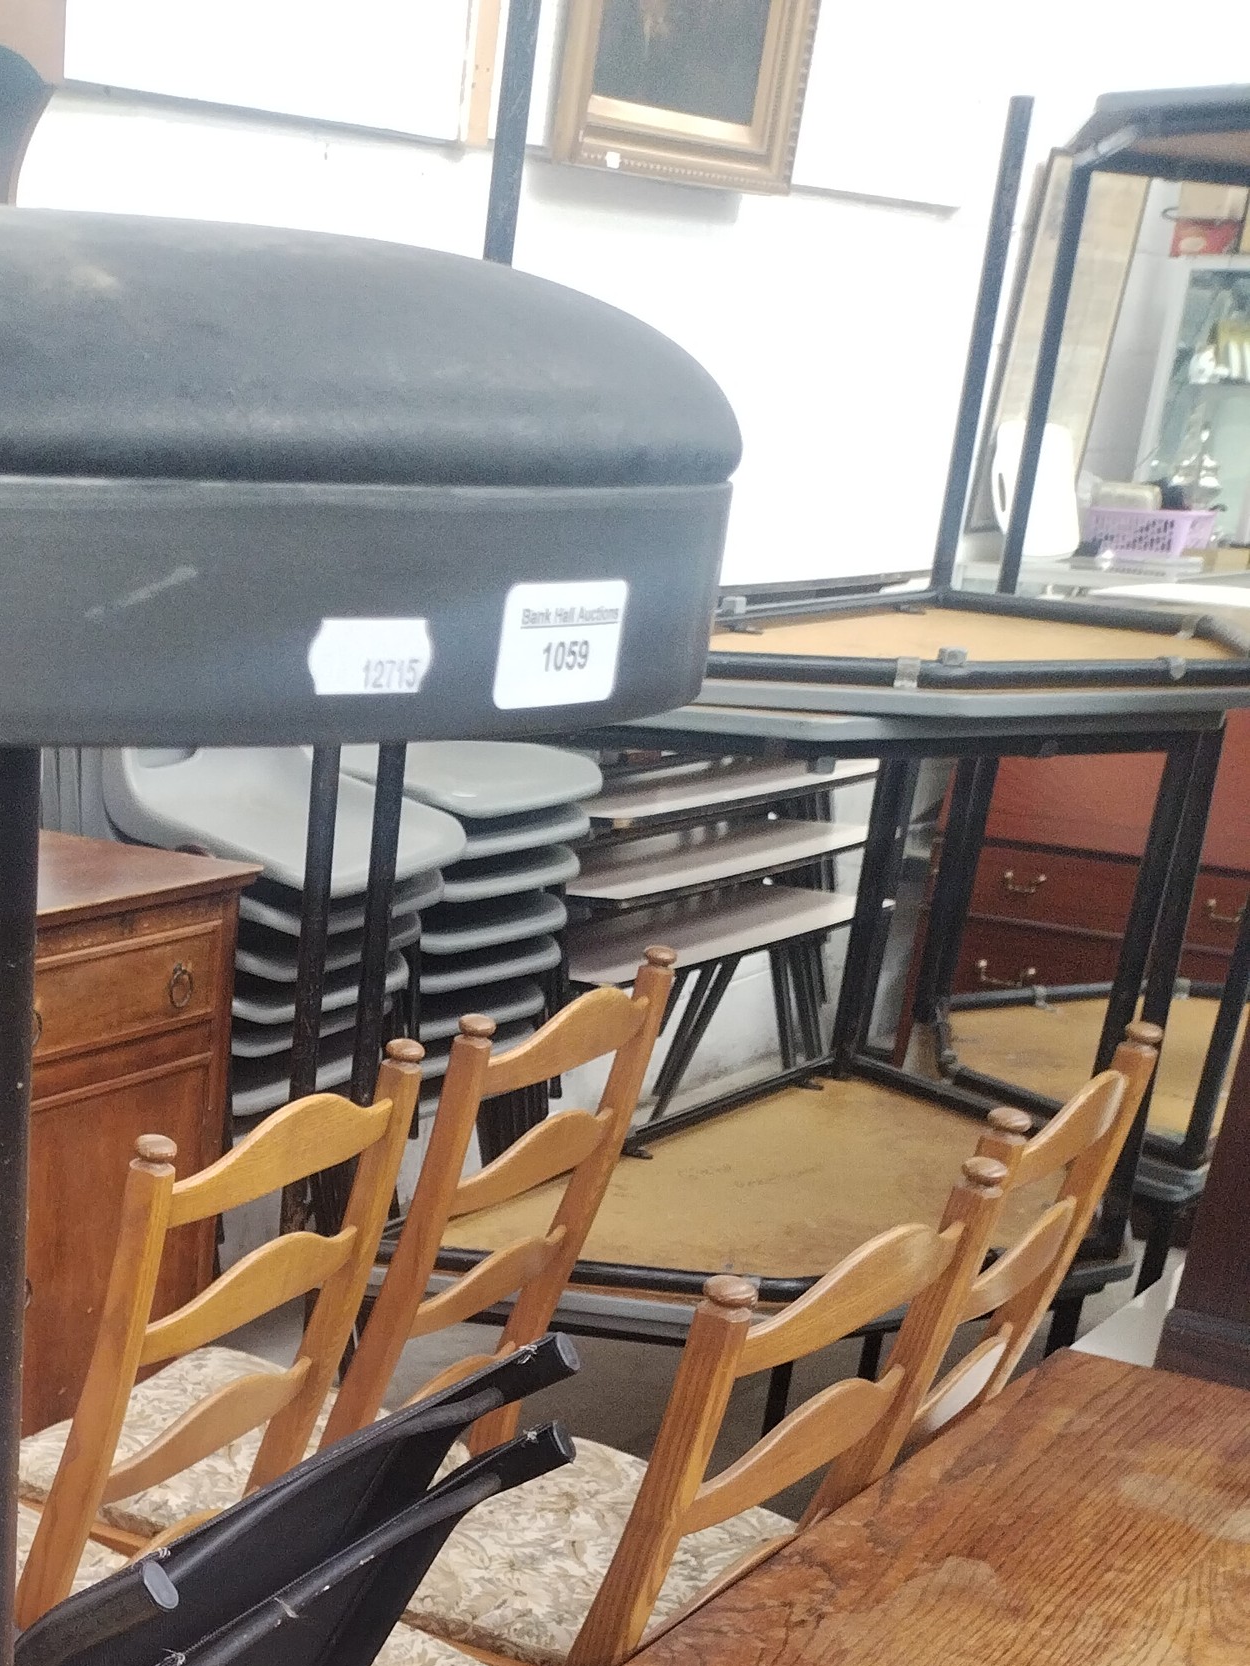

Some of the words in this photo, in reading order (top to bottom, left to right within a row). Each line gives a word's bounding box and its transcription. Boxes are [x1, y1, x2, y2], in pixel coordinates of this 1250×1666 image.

[520, 608, 551, 626] Bank
[554, 607, 576, 624] Hall
[577, 605, 619, 622] Auctions
[543, 640, 589, 672] 1059
[364, 659, 421, 690] 12715
